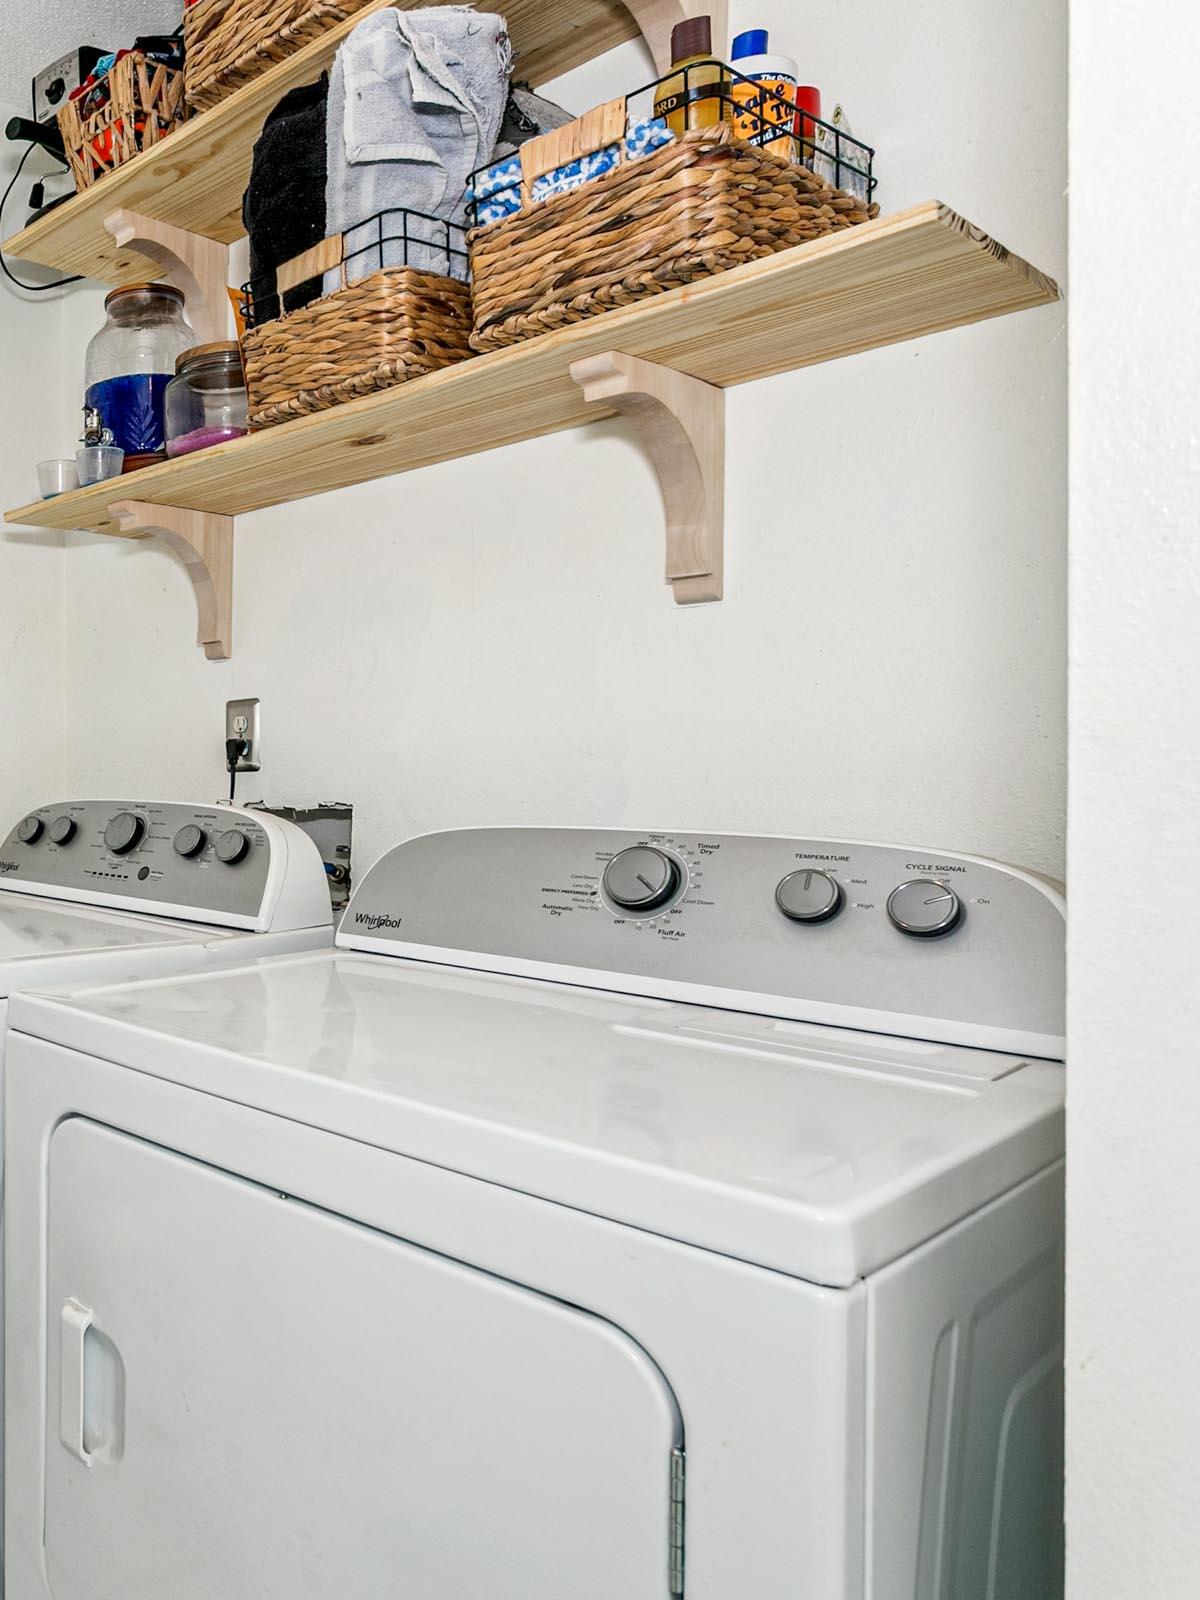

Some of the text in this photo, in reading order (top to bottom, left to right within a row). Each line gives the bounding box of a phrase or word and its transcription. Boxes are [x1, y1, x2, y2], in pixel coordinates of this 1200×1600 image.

[794, 853, 851, 862] TEMPERATURE
[905, 863, 967, 873] CYCLE SIGNAL
[542, 904, 573, 912] Automatic
[550, 909, 561, 917] Dry
[355, 912, 402, 930] Whirlpool
